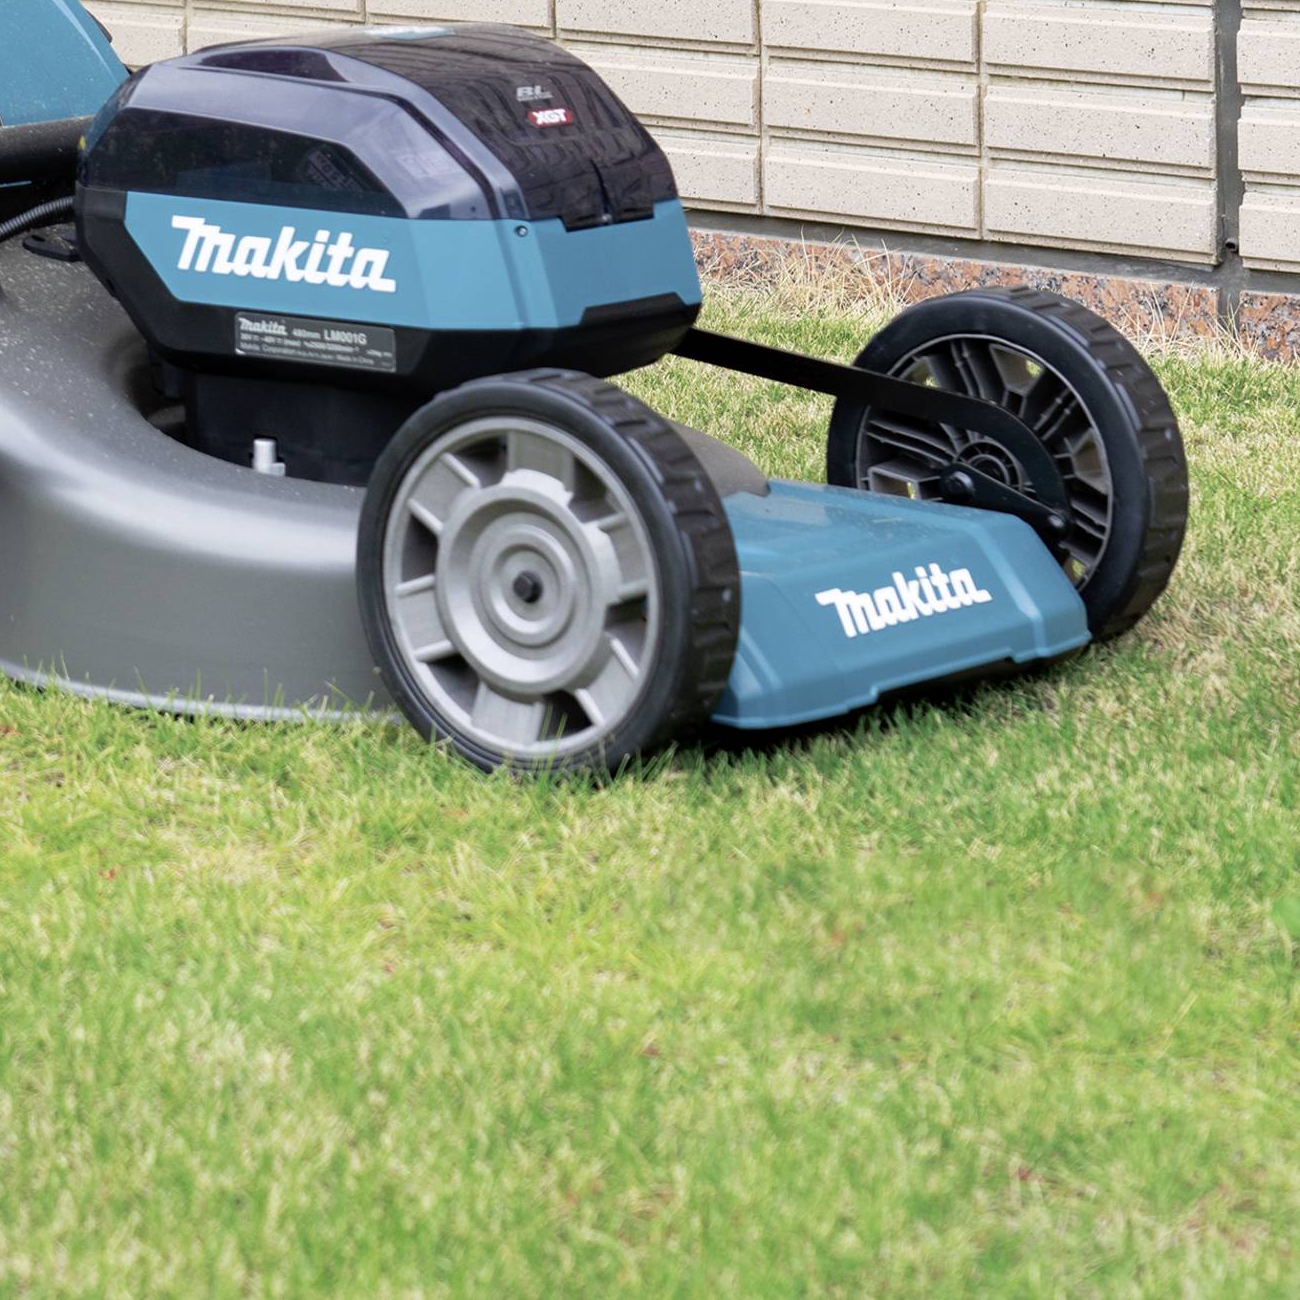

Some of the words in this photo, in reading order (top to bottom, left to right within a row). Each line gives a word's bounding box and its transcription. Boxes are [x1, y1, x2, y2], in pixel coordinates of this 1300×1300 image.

[172, 215, 396, 292] Makita
[324, 328, 368, 345] LM001G
[815, 563, 992, 637] Makita
